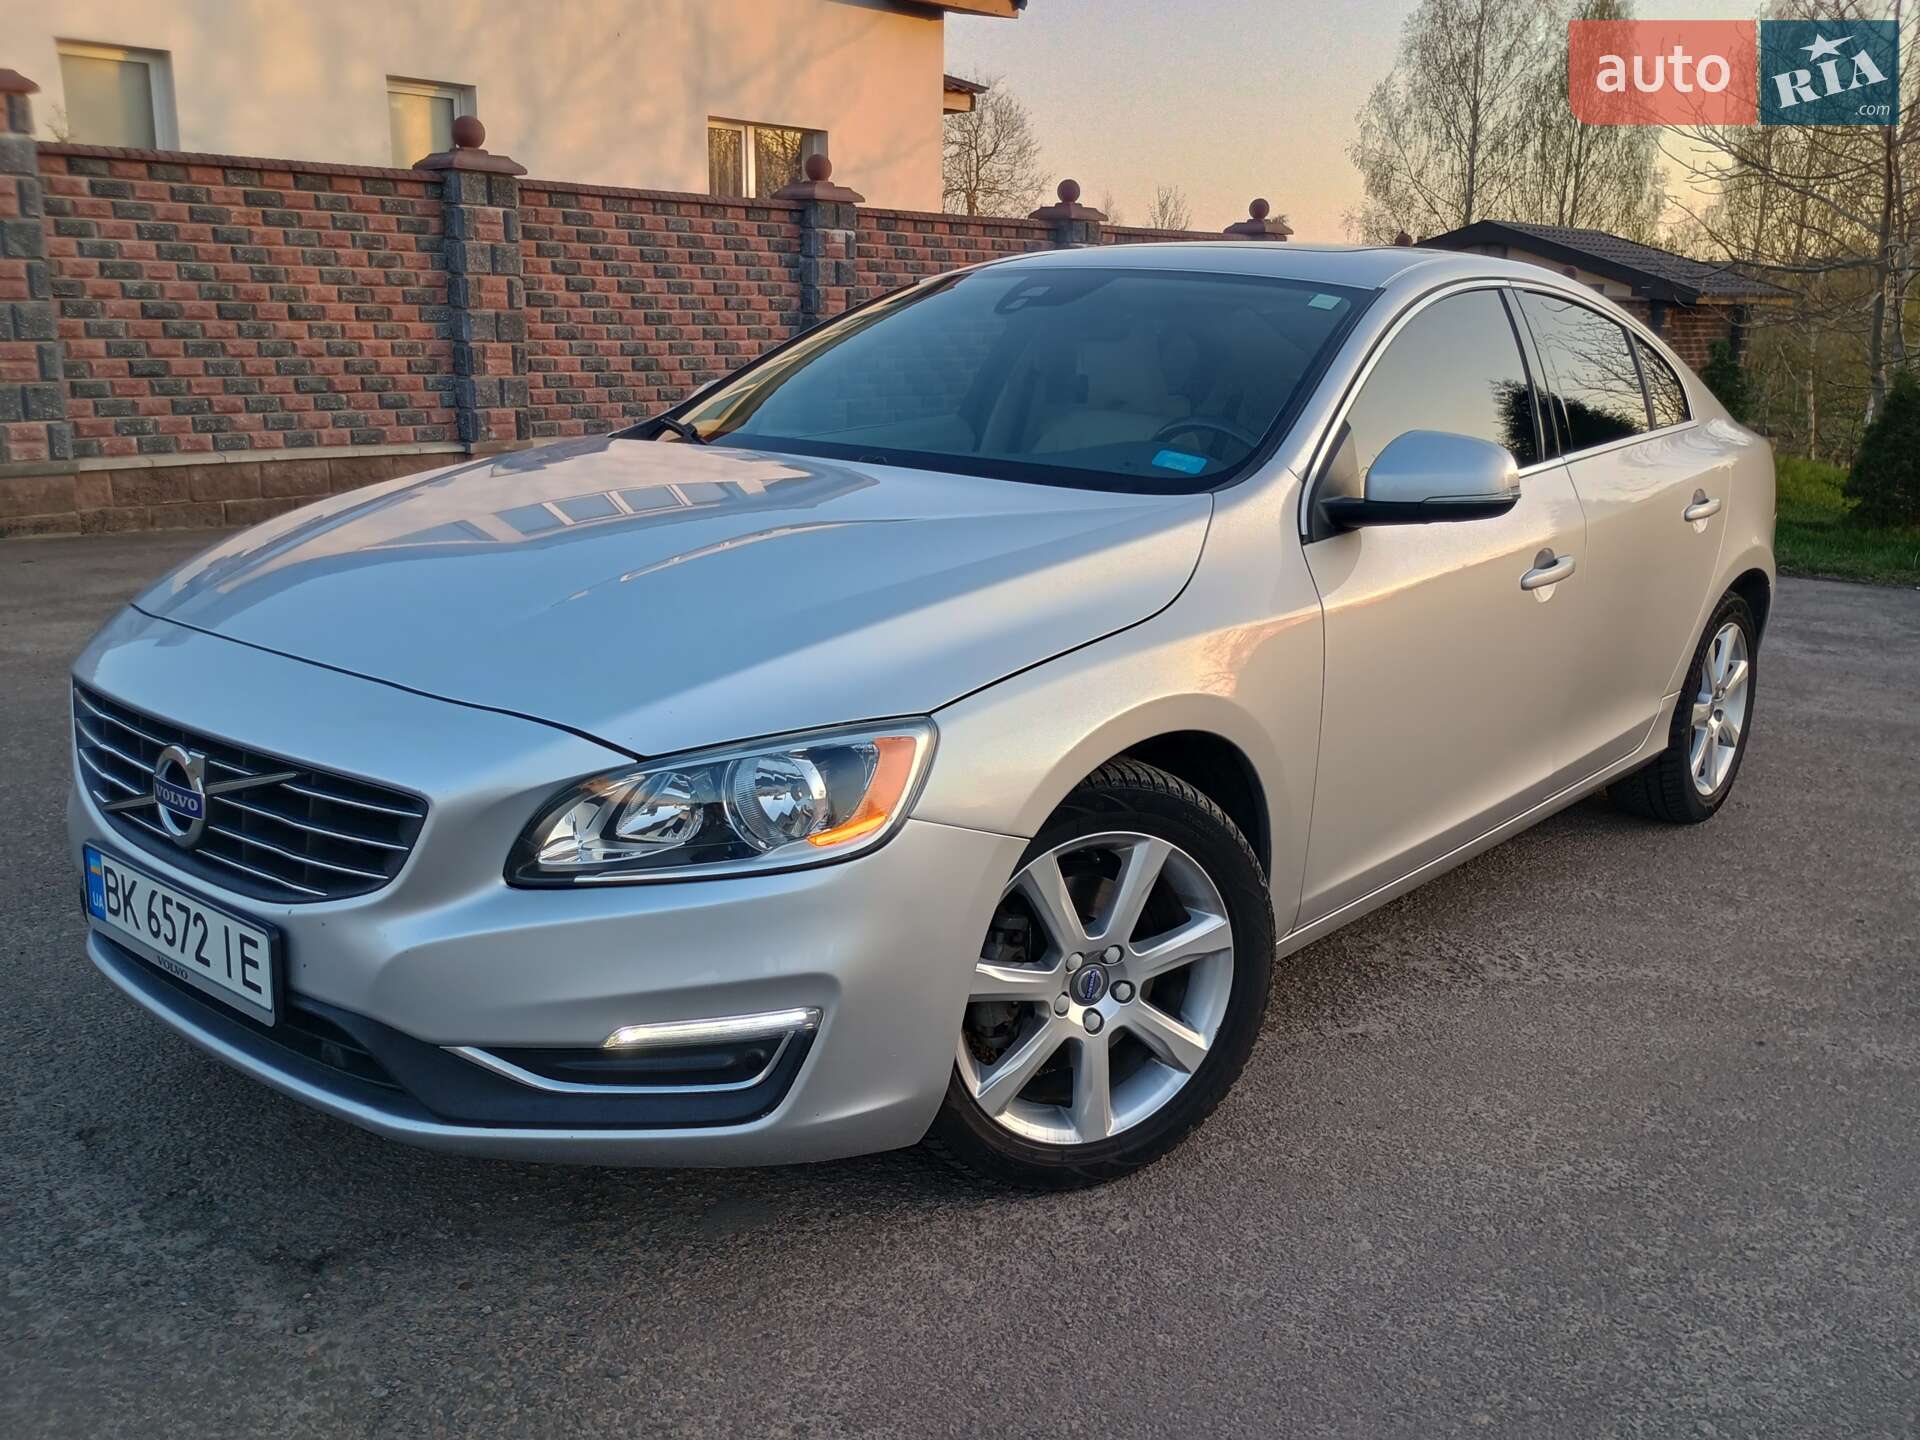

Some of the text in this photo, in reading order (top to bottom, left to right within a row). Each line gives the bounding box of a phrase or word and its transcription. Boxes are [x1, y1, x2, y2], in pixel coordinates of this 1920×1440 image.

[155, 783, 199, 811] VOLVO
[92, 892, 104, 910] UA
[104, 865, 263, 995] BK 6572 IE
[157, 955, 189, 979] VOLVO
